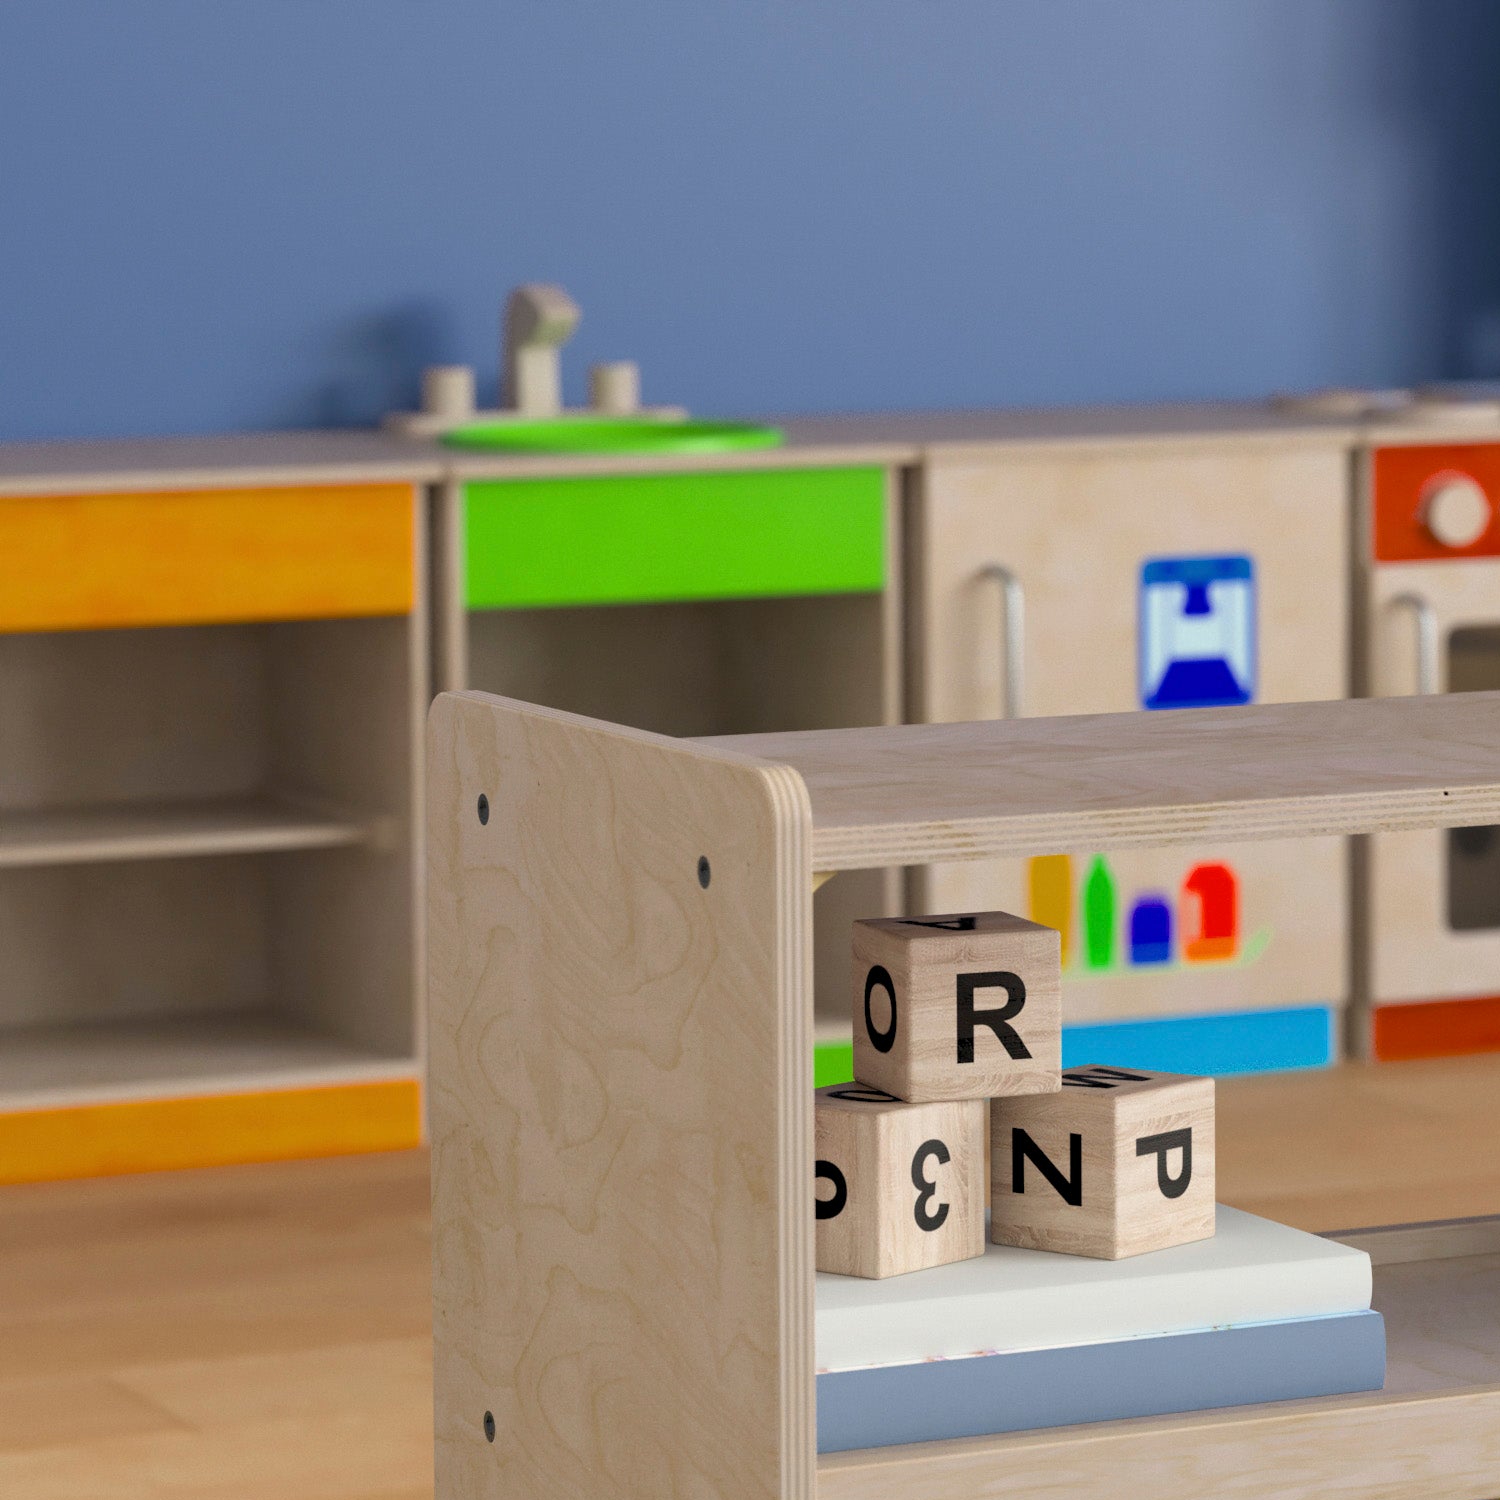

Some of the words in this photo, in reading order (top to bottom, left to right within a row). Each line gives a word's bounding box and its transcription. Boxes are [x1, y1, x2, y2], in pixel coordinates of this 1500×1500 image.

[956, 971, 1034, 1064] R
[1012, 1127, 1082, 1207] N
[1136, 1127, 1192, 1199] P
